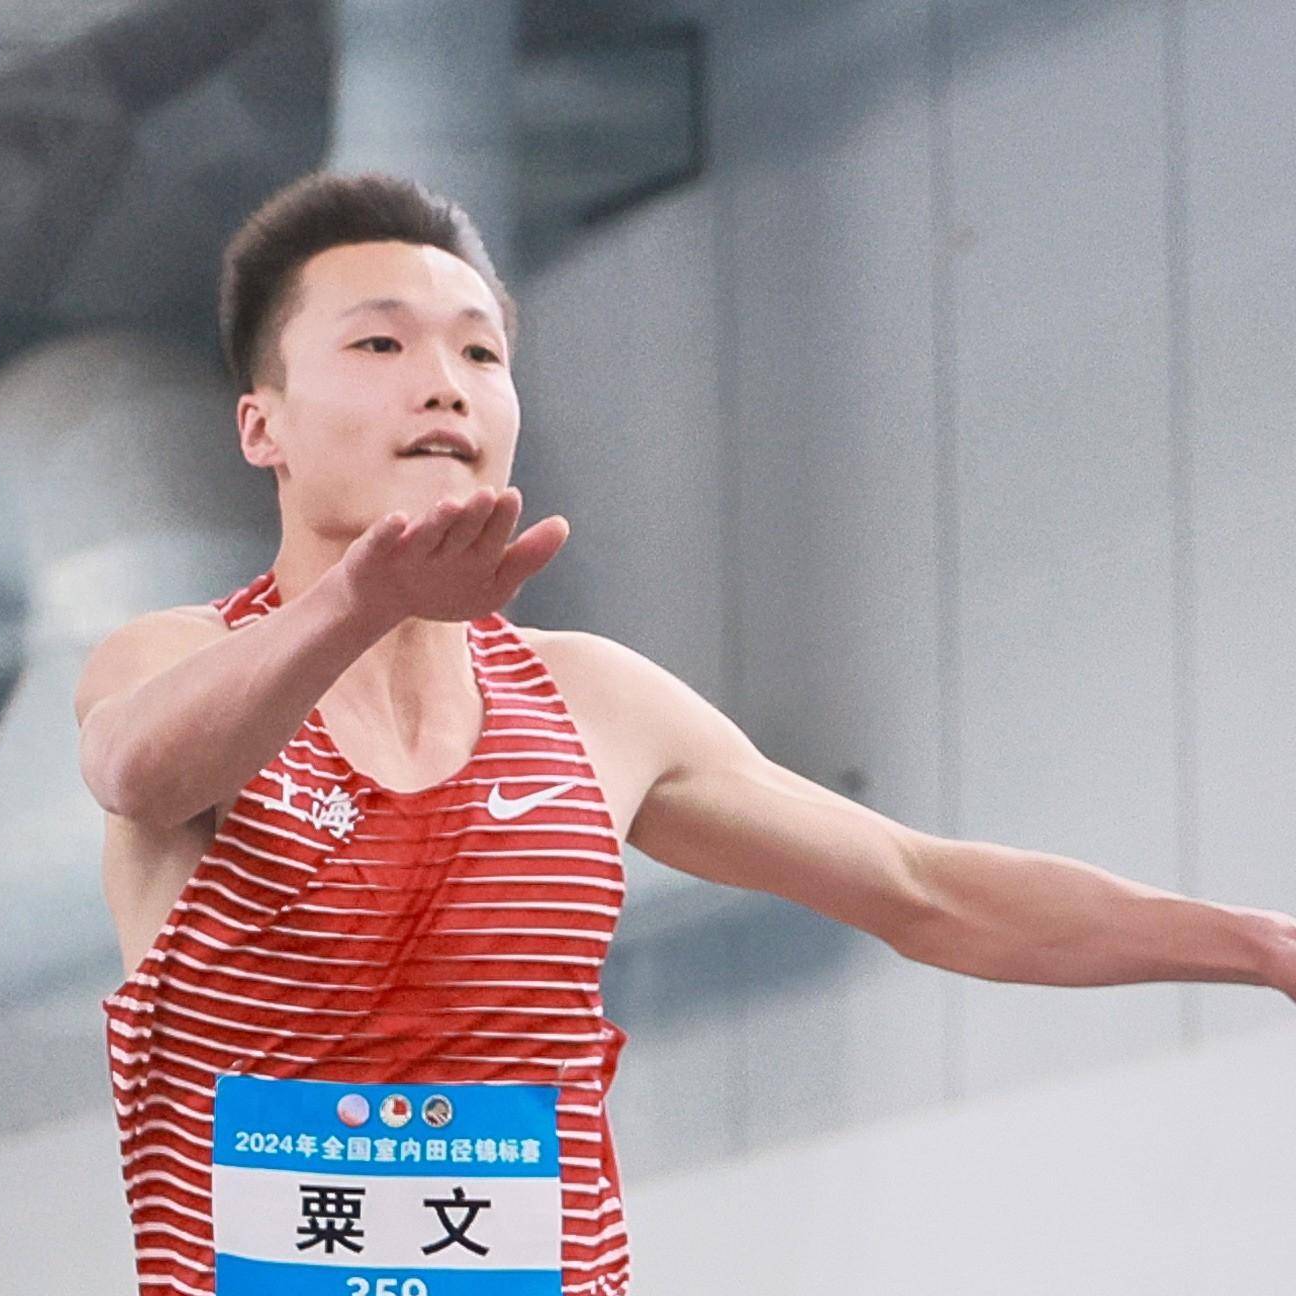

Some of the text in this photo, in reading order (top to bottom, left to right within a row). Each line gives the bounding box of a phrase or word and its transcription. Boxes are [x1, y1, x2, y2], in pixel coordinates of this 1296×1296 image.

[261, 772, 365, 844] 上海
[234, 1130, 542, 1165] 2024年全国室内田径锦标赛
